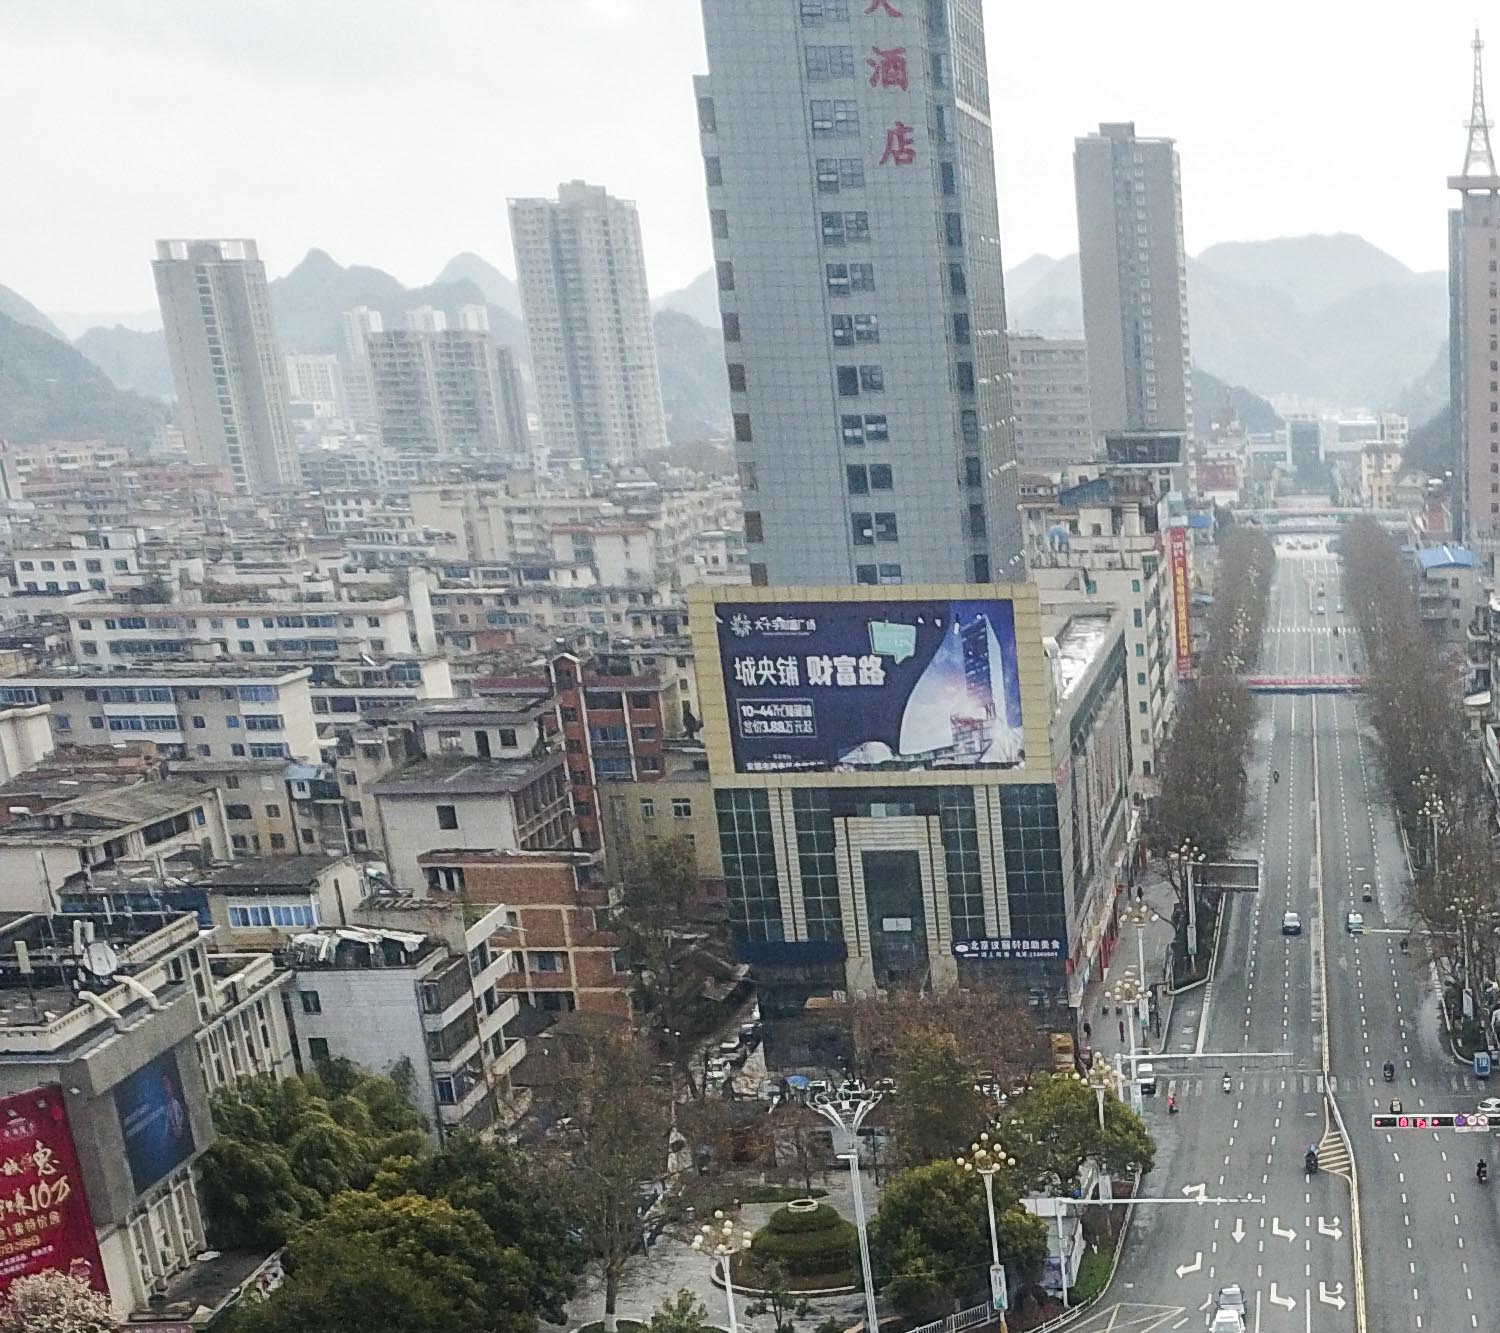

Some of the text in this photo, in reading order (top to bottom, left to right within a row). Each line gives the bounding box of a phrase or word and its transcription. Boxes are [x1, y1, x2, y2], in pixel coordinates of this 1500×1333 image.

[734, 654, 885, 686] 城央铺 财富路
